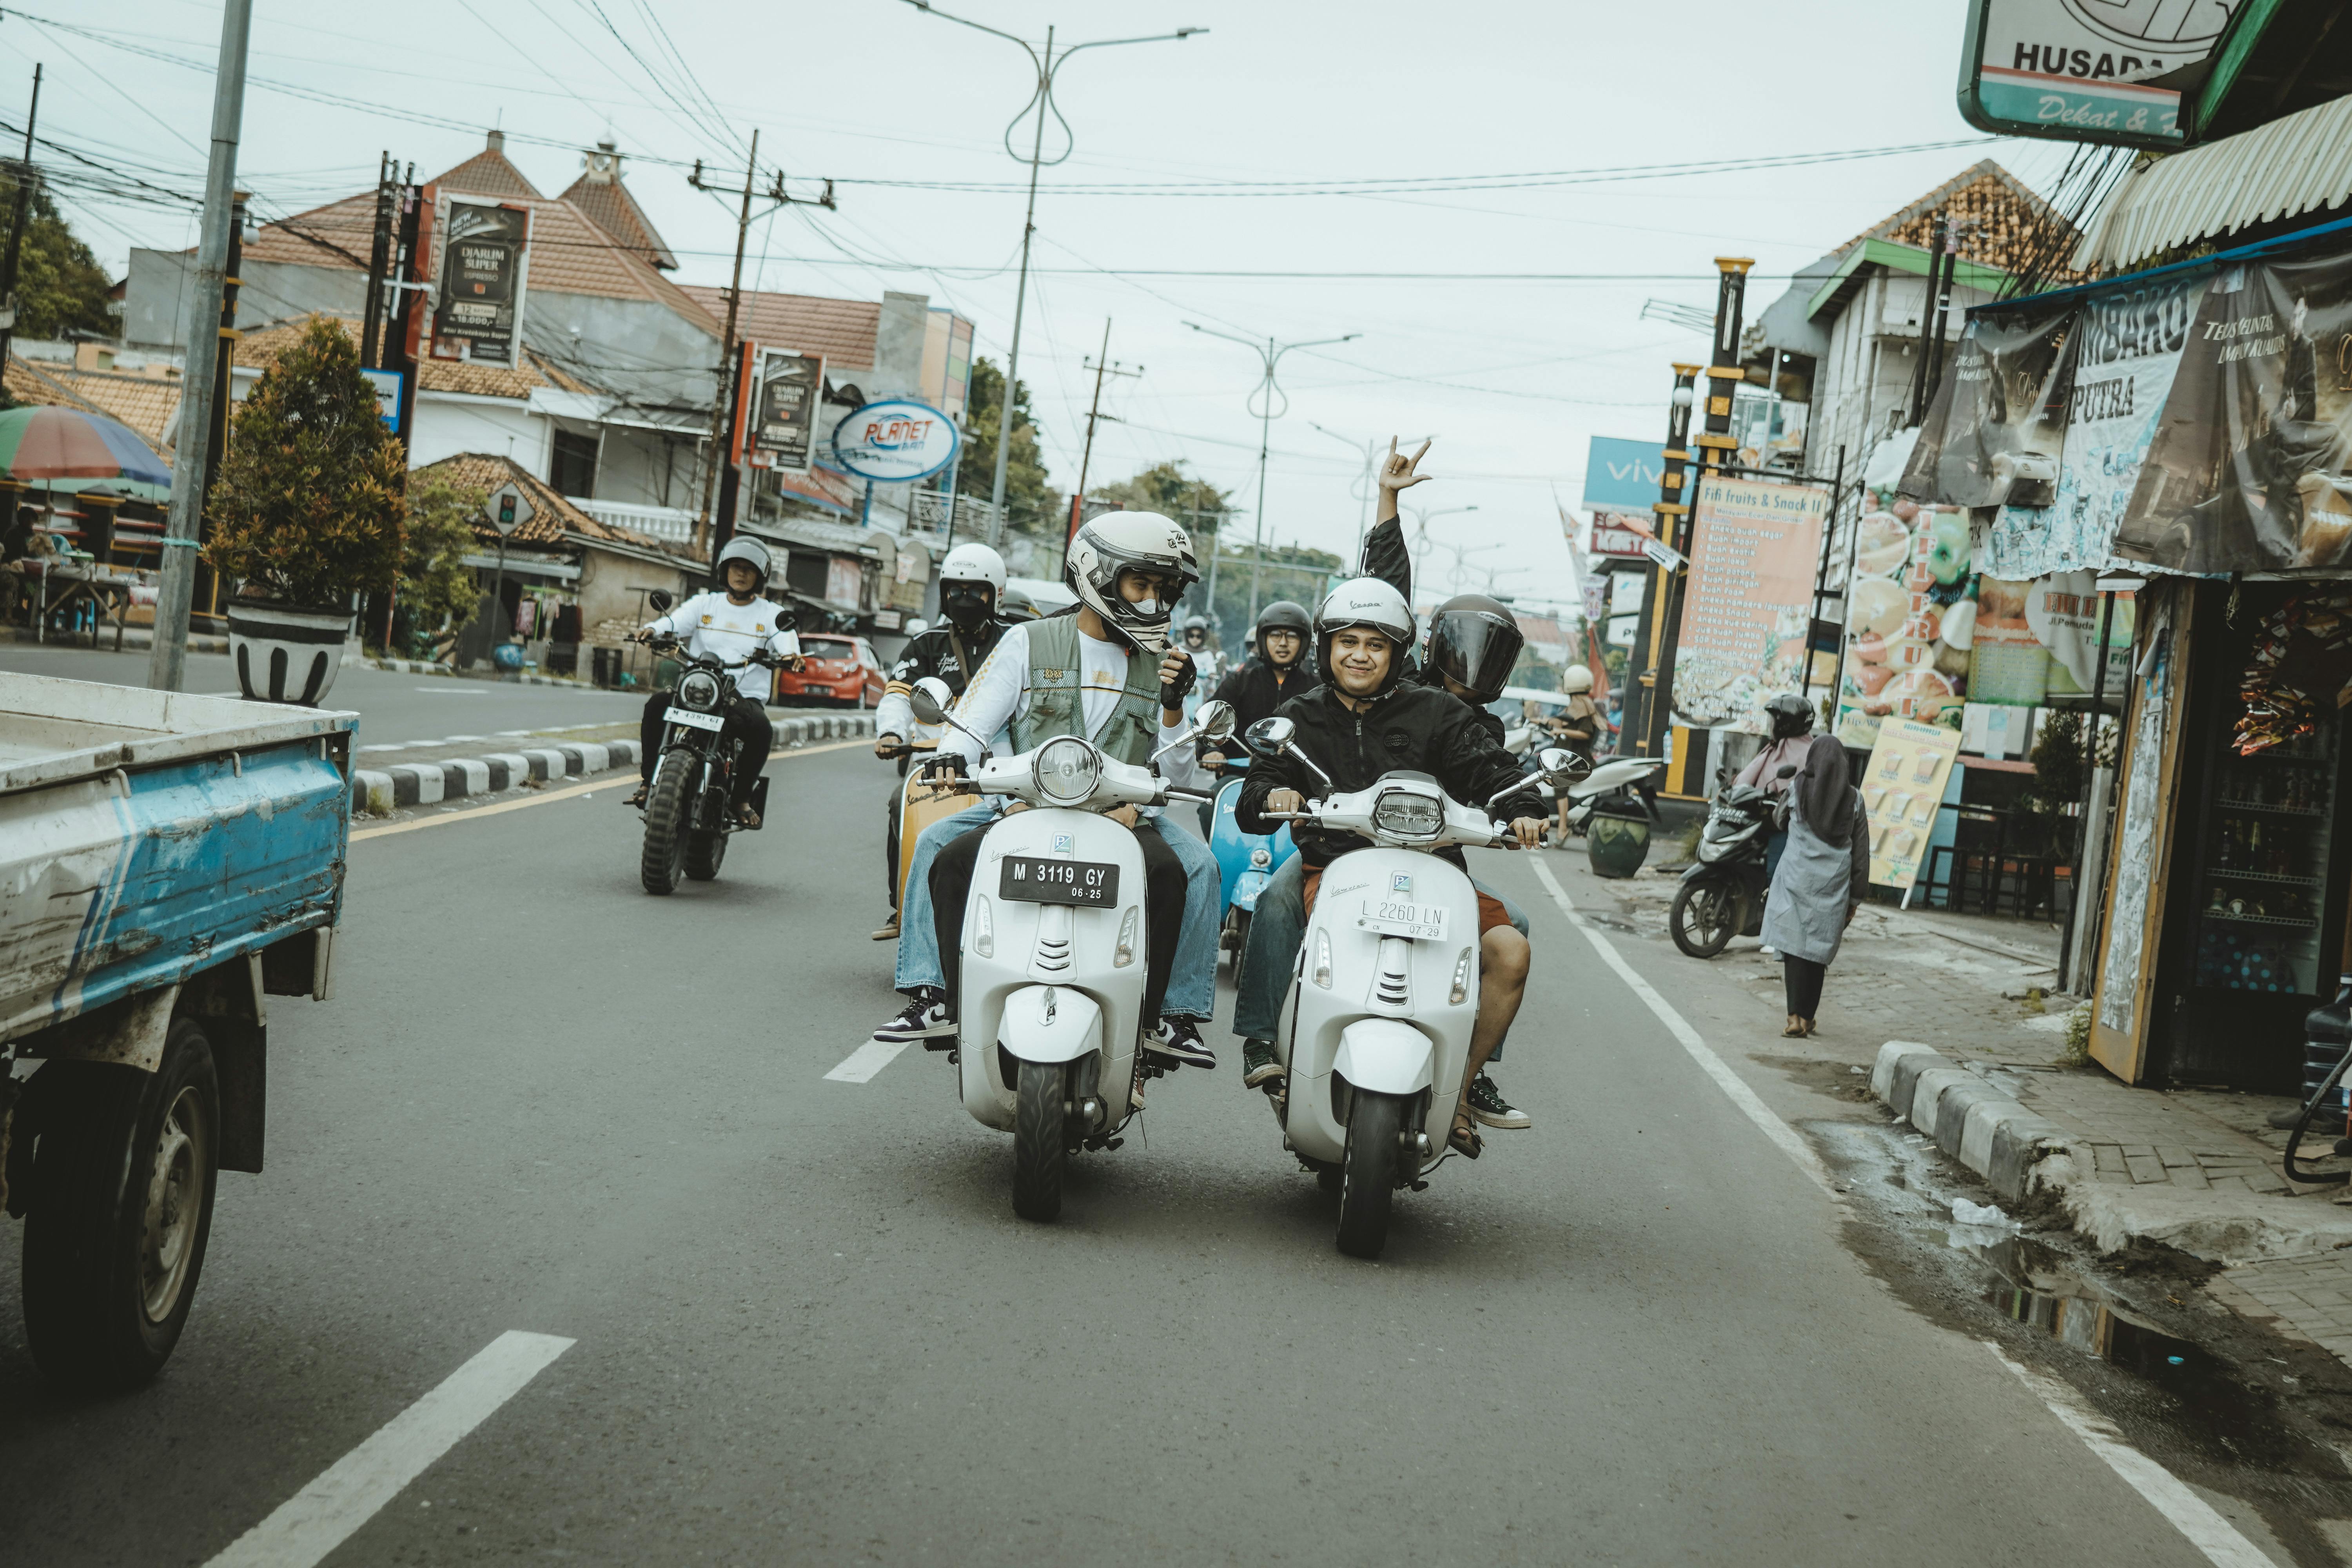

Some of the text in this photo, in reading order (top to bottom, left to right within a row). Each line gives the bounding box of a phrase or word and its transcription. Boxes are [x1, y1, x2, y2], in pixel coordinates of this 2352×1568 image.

[2038, 96, 2118, 128] Dekat
[2125, 107, 2149, 131] &
[462, 247, 505, 261] DJARUM
[2070, 375, 2135, 426] PUTRA
[864, 420, 933, 443] PLANET
[1704, 487, 1722, 501] Fifi
[1725, 489, 1757, 506] fruits
[1761, 494, 1769, 507] &
[1774, 495, 1806, 512] Snack
[1109, 538, 1136, 550] CLASSIC
[1350, 600, 1382, 610] Vespa
[1014, 863, 1105, 886] M 3119 GY
[1362, 900, 1441, 924] L 2260 LN
